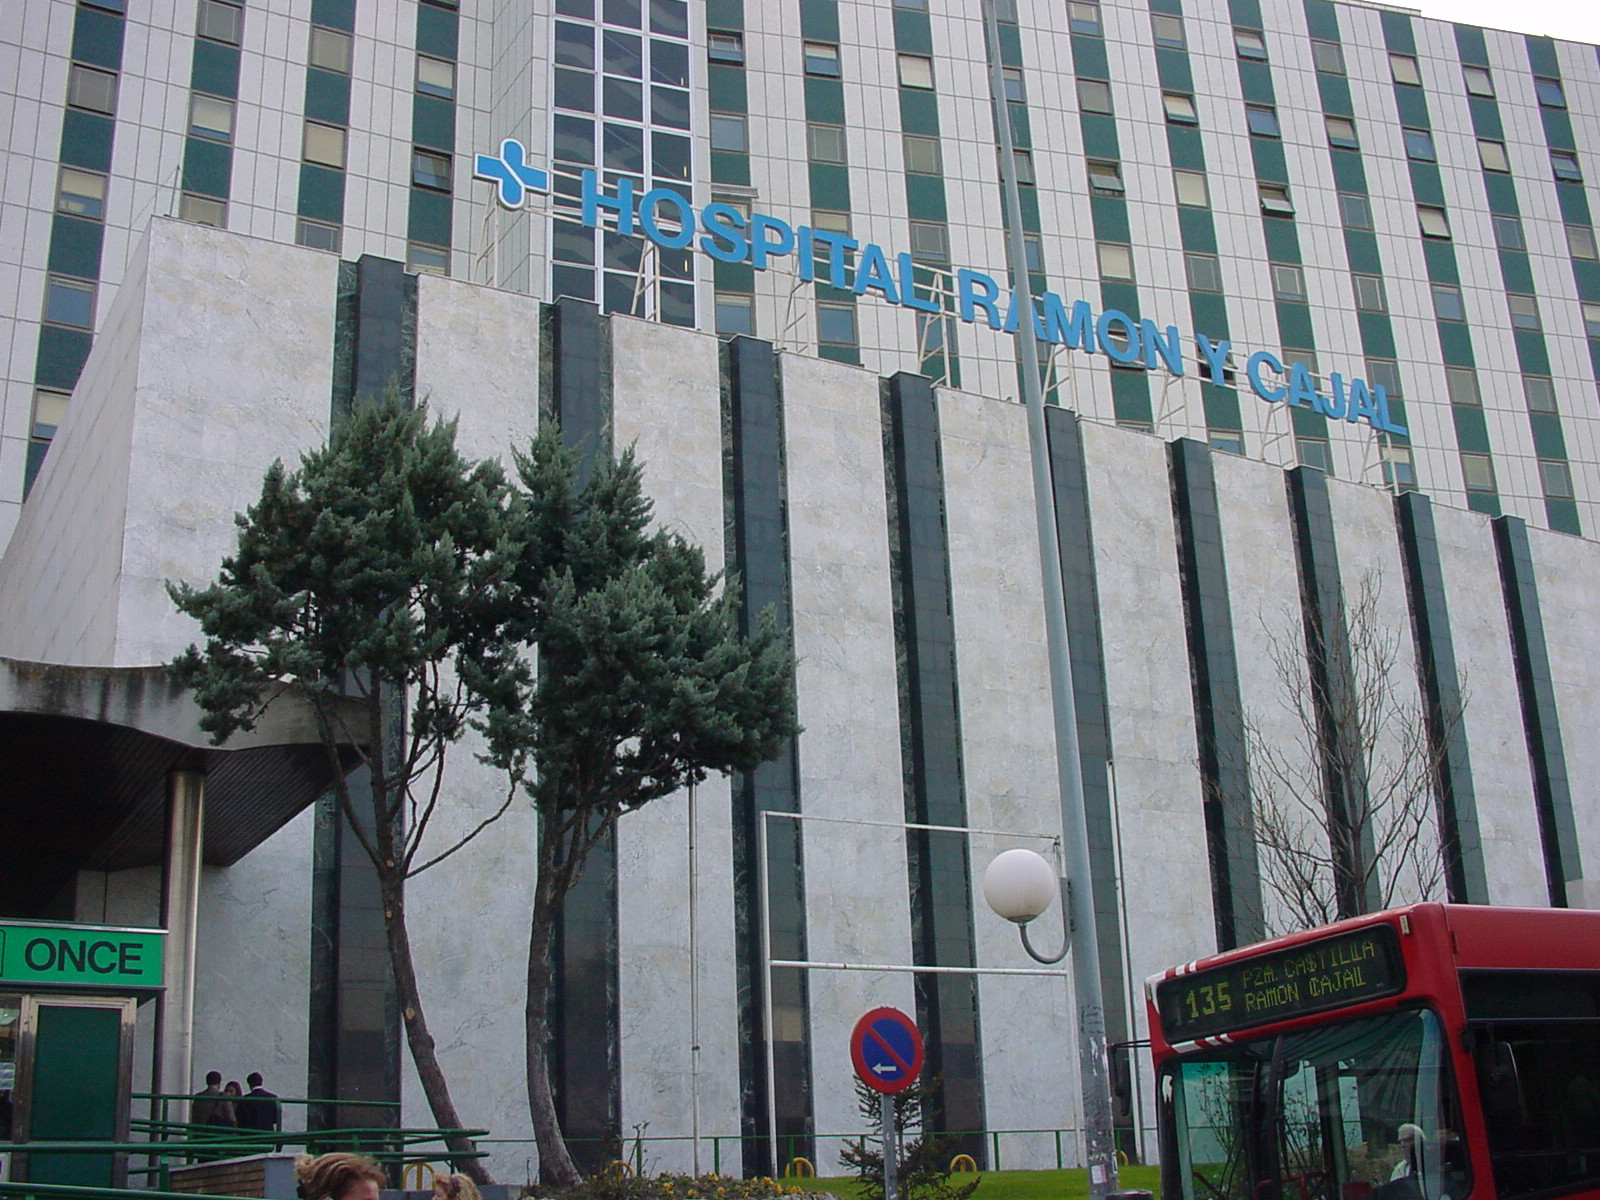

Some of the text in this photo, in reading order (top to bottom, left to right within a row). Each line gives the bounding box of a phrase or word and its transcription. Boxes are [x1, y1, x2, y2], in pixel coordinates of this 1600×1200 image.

[581, 169, 940, 313] HOSPITAL
[1196, 333, 1230, 387] Y
[1247, 351, 1408, 436] CAJAL
[24, 937, 144, 976] ONCE
[1284, 940, 1375, 978] CASTILLA
[1186, 981, 1232, 1018] 135
[1244, 966, 1367, 1012] RAMON CAJAL
